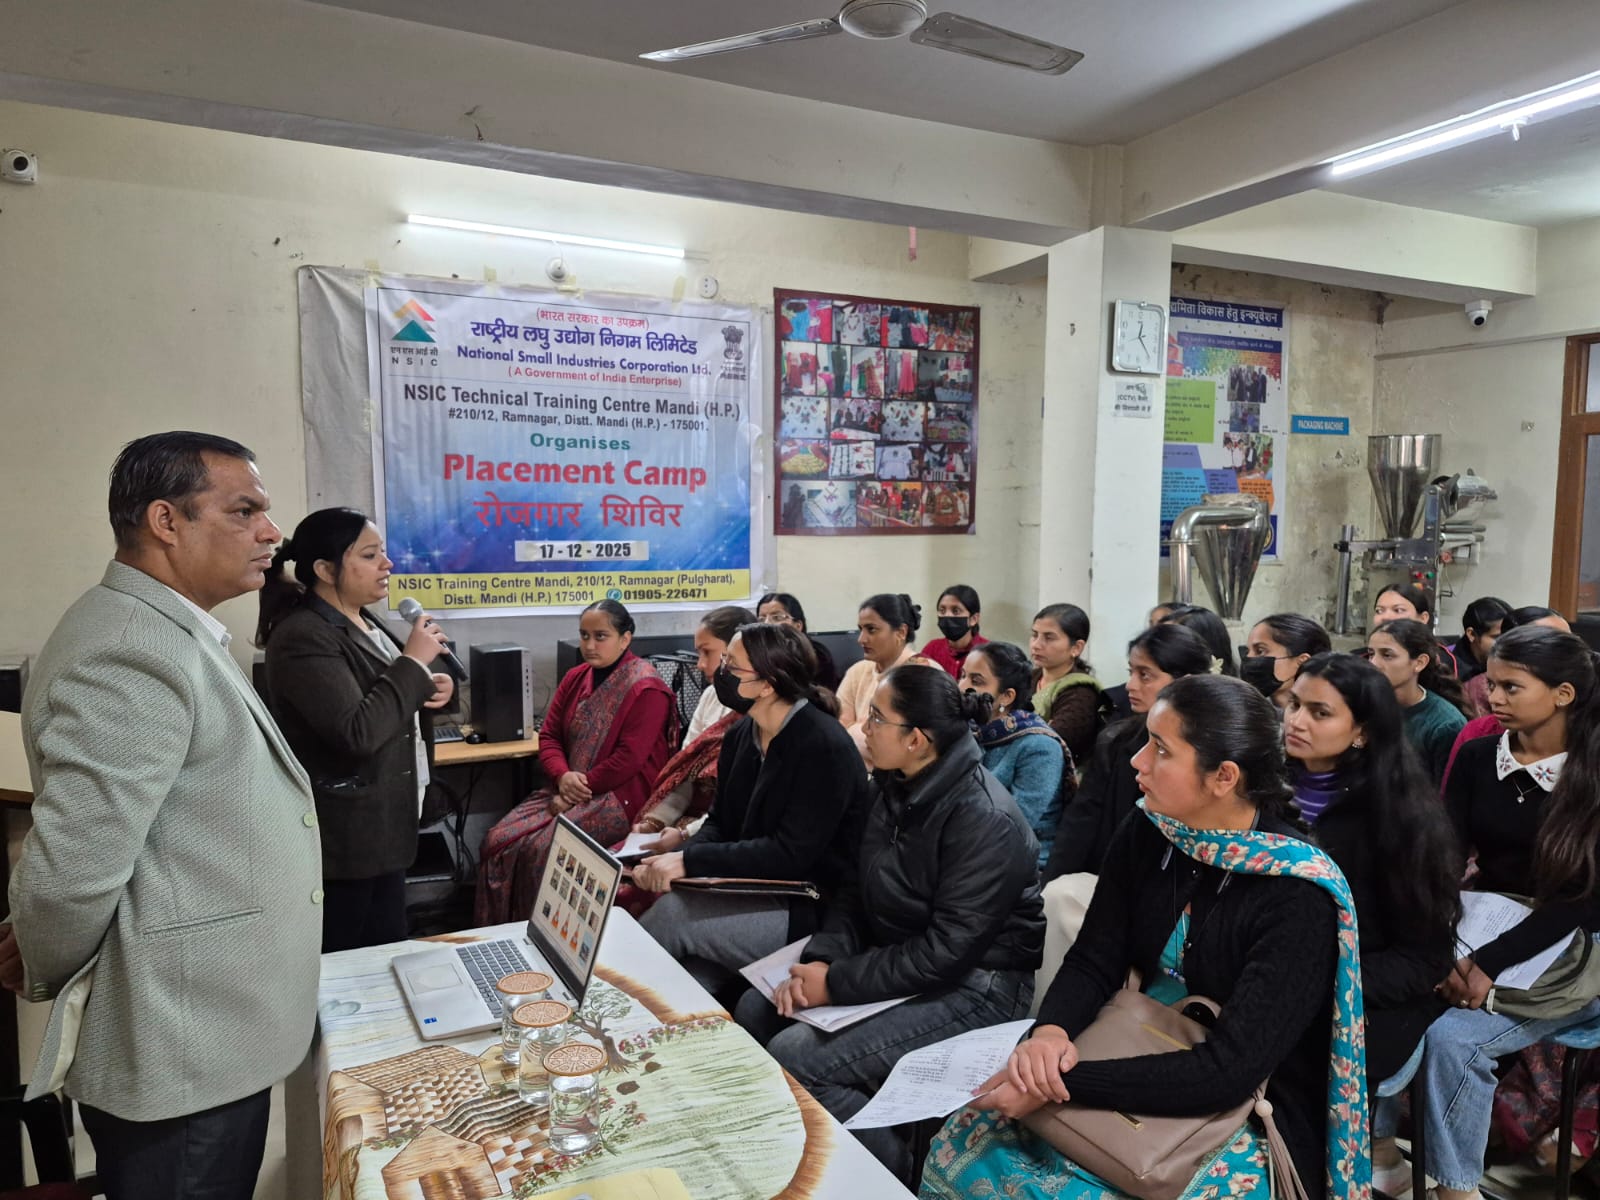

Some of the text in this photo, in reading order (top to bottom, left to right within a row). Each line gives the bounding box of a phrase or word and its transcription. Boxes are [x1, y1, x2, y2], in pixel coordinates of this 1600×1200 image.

[536, 307, 650, 331] (भारत सरकार का उपक्रम)
[1171, 299, 1196, 315] द्यमिता
[1198, 301, 1225, 318] विकास
[1226, 304, 1239, 322] हेतु
[470, 317, 699, 355] राष्ट्रीय लघु उद्योग निगम लिमिटेड
[457, 345, 514, 363] National
[518, 349, 553, 366] Small
[556, 353, 616, 370] Industries
[619, 358, 689, 375] Corporation
[691, 362, 712, 376] Ltd.
[514, 367, 522, 376] A
[525, 368, 587, 382] Government
[590, 373, 600, 382] of
[602, 374, 627, 384] India
[629, 374, 682, 388] Enterprise)
[404, 384, 741, 421] NSIC Technical Training Centre Mandi (H.P.)
[448, 407, 498, 422] #210/12,
[502, 410, 561, 426] Ramnagar,
[564, 414, 593, 427] Distt.
[596, 415, 629, 428] Mandi
[631, 417, 661, 432] (H.P.)
[671, 419, 710, 432] 175001.
[529, 432, 632, 451] Organises
[444, 453, 707, 493] Placement Camp
[473, 491, 684, 527] रोजगार शिविर
[540, 544, 554, 558] 17
[567, 543, 583, 558] 12
[595, 543, 632, 558] 2025
[398, 574, 735, 590] NSIC Training Centre Mandi, 210/12, Ramnagar (Pulgharat),
[444, 588, 708, 606] Distt. Mandi (H.P.) 175001 01905-226471
